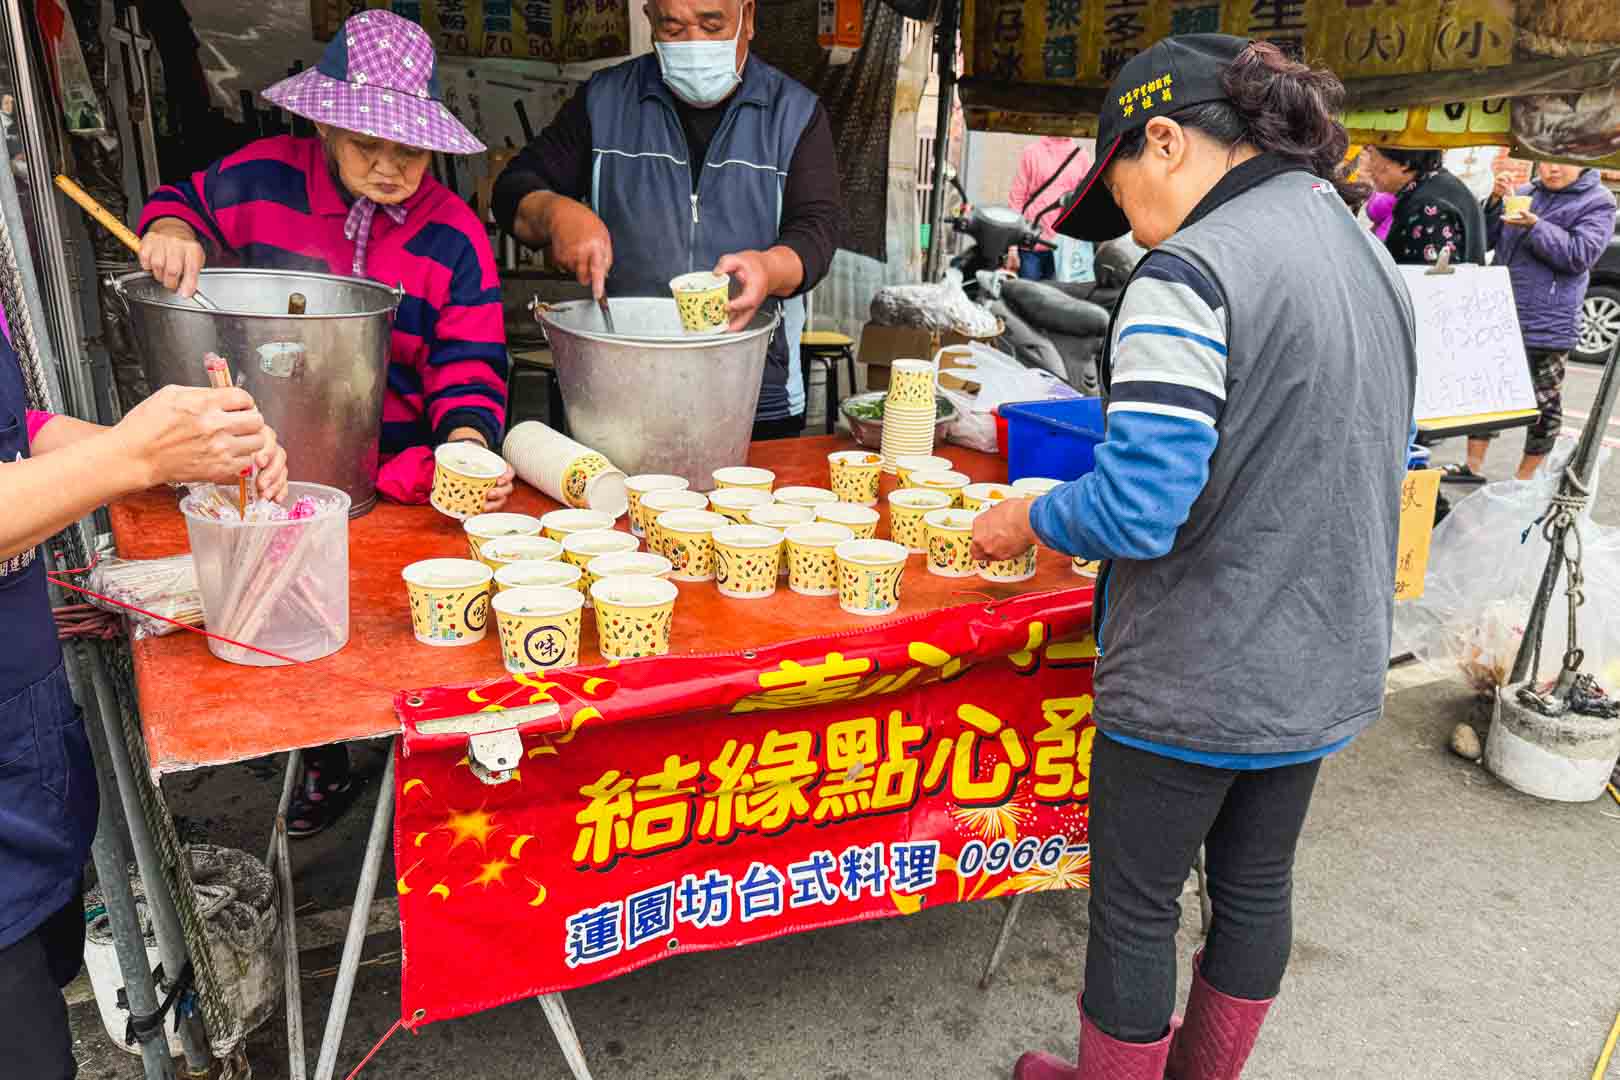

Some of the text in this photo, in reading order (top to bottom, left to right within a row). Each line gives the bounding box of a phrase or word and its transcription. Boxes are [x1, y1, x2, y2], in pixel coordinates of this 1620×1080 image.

[533, 633, 559, 658] 味
[564, 838, 940, 968] 蓮園坊台式料理
